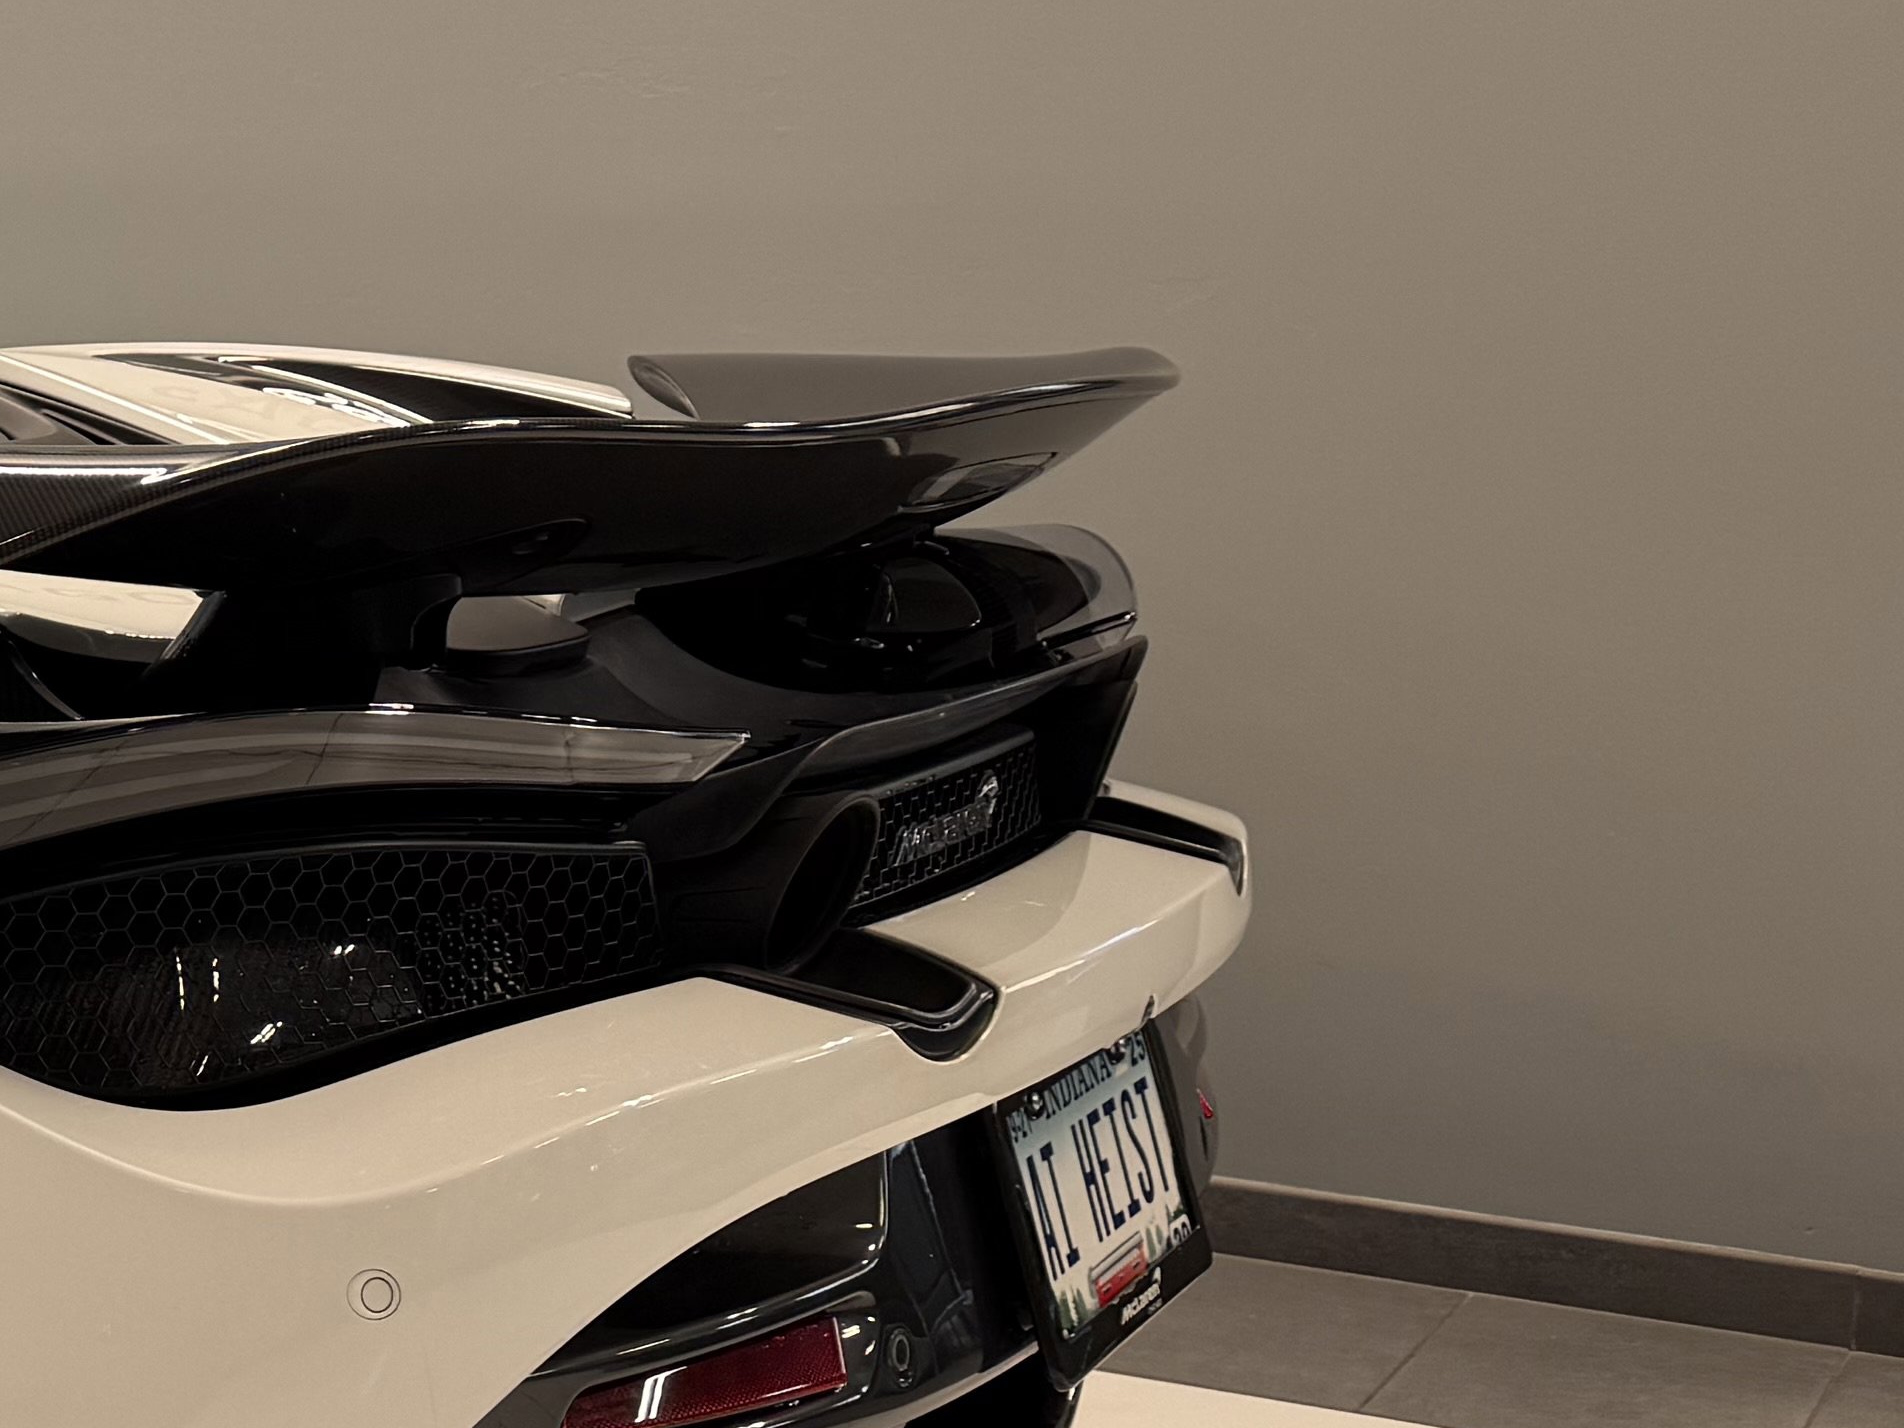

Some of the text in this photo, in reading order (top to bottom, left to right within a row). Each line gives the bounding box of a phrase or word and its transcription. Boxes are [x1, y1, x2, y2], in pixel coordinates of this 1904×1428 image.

[1043, 1051, 1112, 1120] INDIANA
[1026, 1075, 1171, 1282] AI HEIST
